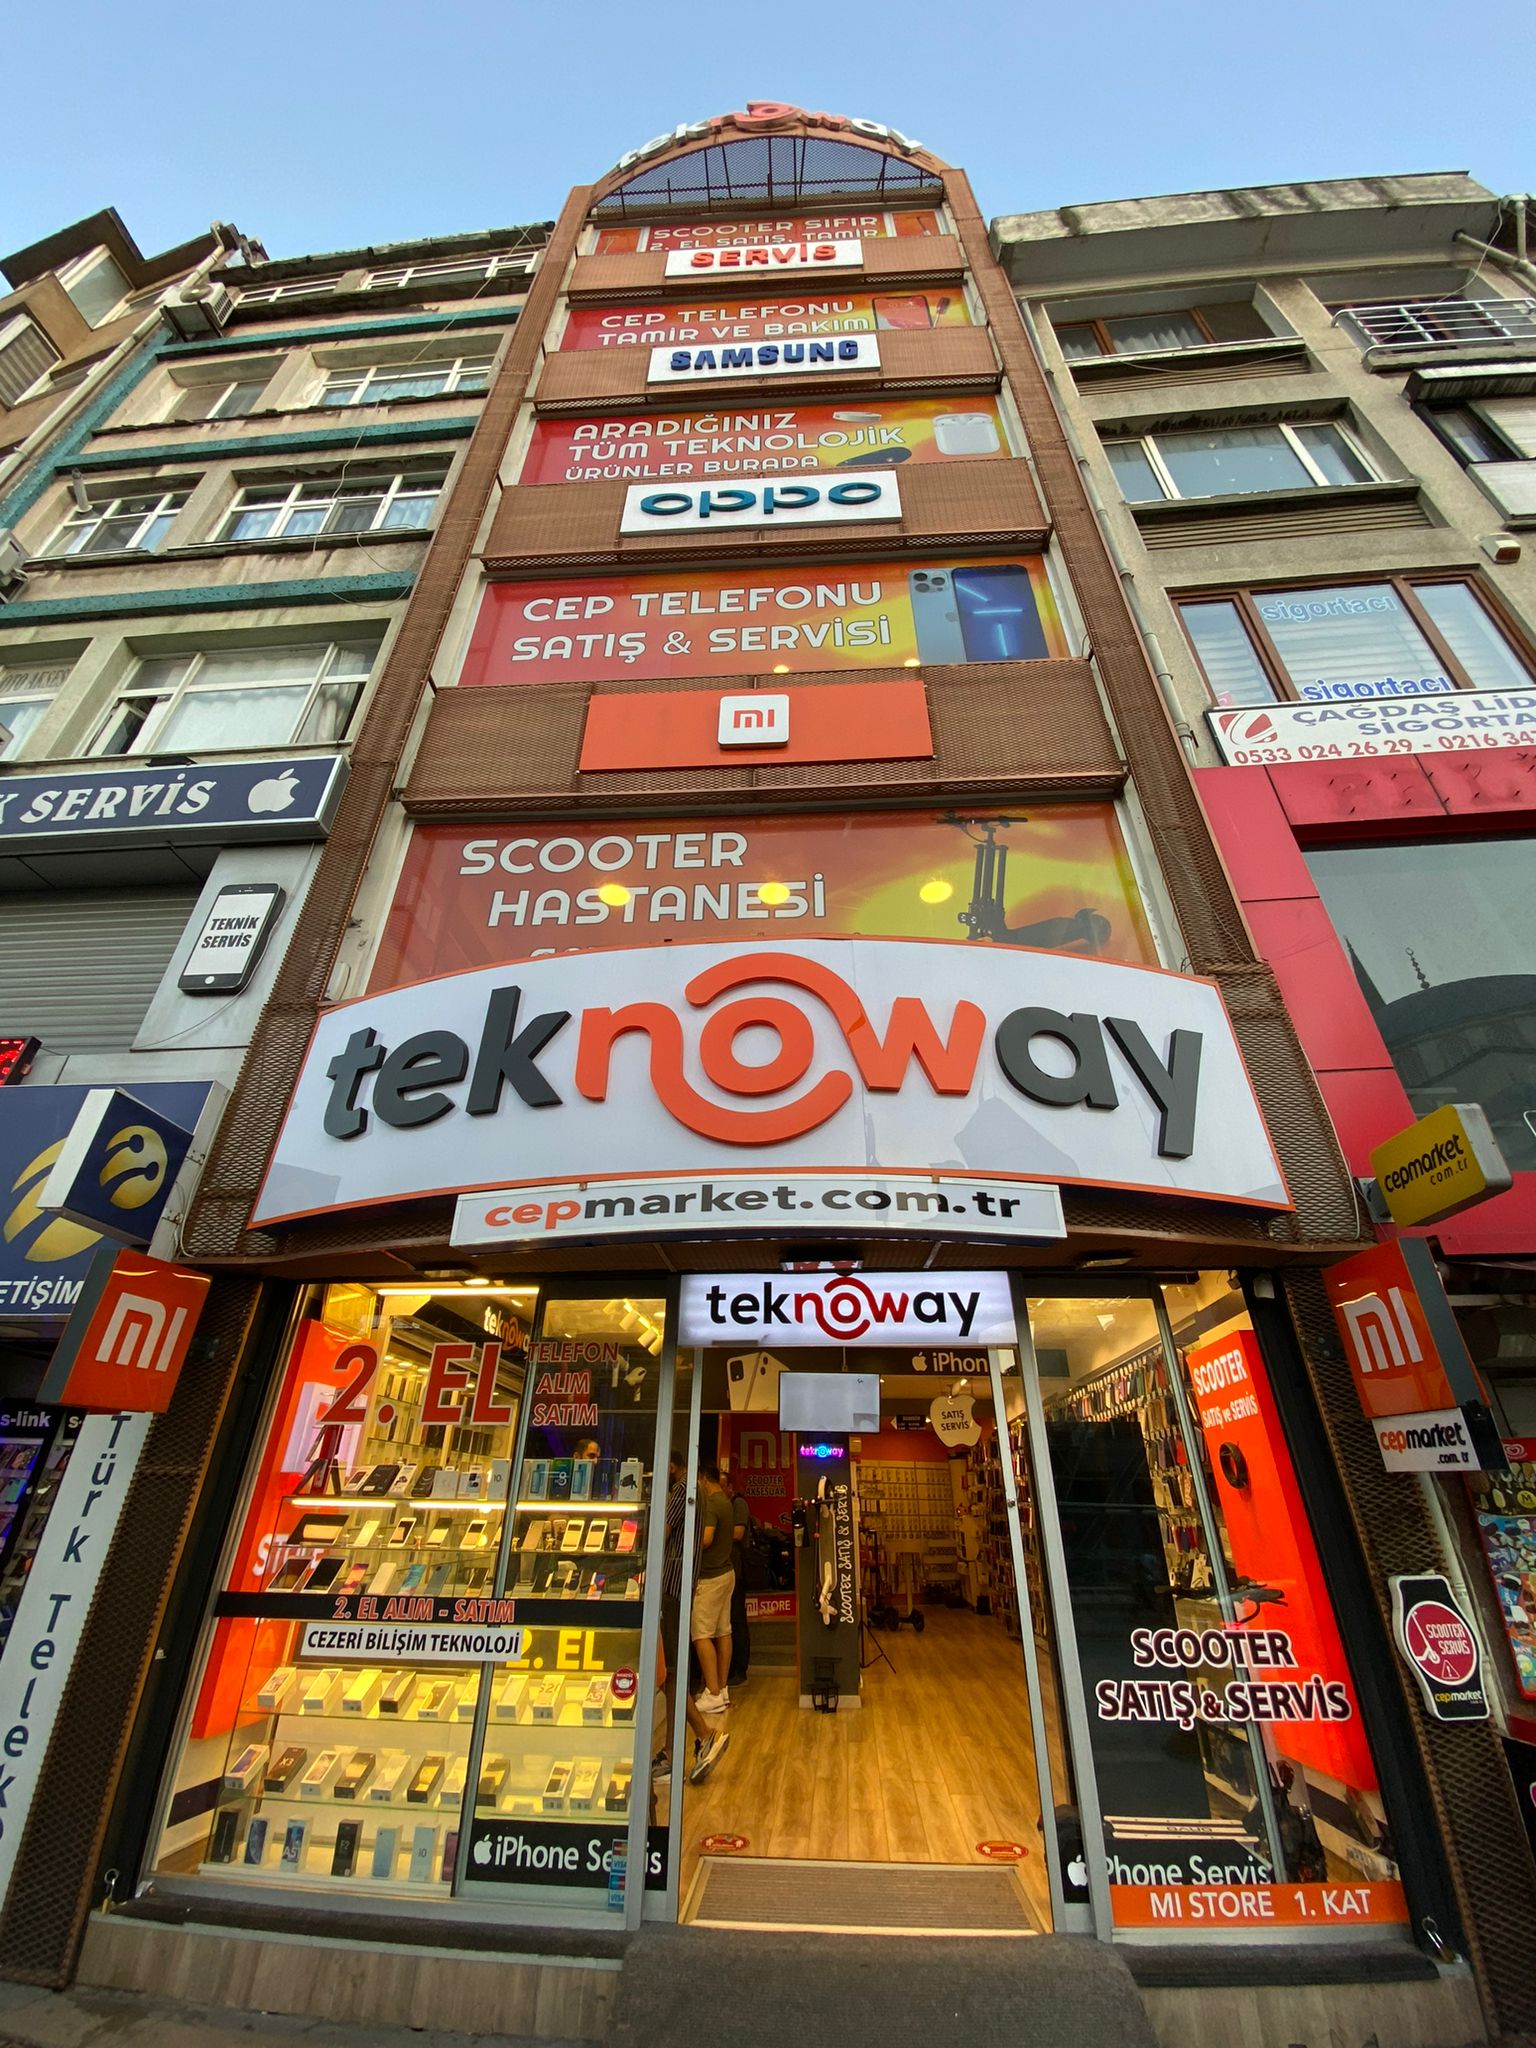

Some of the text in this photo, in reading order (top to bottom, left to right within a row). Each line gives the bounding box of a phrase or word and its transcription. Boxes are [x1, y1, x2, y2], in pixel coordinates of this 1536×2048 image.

[654, 216, 878, 240] SCOOTER SIFIR
[680, 240, 707, 249] EL
[801, 227, 878, 240] TAMİR
[691, 241, 836, 268] SERVİS
[601, 301, 853, 328] CEP TELEFONU
[598, 317, 869, 346] TAMİR VE BAKIM
[670, 340, 859, 371] SAMSUNG
[573, 411, 798, 440] ARADIĞINIZ
[568, 426, 906, 462] TÜM TEKNOLOJİK
[565, 455, 818, 481] ÜRÜNLER BURADA
[640, 482, 882, 518] oppo
[522, 581, 882, 622] CEP TELEFONU
[511, 615, 891, 664] SATIŞ & SERVİSİ
[1292, 698, 1460, 726] ÇAĞDAŞ
[1359, 712, 1536, 736] SİGORTA
[1234, 747, 1292, 764] 0533
[1299, 742, 1342, 760] 024
[1347, 740, 1378, 756] 26
[1384, 738, 1412, 754] 29
[1438, 733, 1498, 750] 0216
[1502, 730, 1536, 746] 34
[19, 773, 217, 824] SERVİS
[458, 832, 748, 875] SCOOTER
[487, 872, 826, 927] HASTANESİ
[209, 914, 260, 931] TEKNİK
[201, 932, 252, 949] SERVİS
[323, 952, 1203, 1158] teknoway
[1384, 1133, 1465, 1193] cepmarket
[484, 1184, 1020, 1230] cepmarket.com.tr
[706, 1276, 980, 1341] teknoway
[528, 1341, 619, 1363] TELEFON
[933, 1351, 989, 1373] iPhon
[320, 1342, 515, 1427] 2. EL
[536, 1372, 590, 1395] ALIM
[1193, 1349, 1248, 1396] SCOOTER
[0, 1410, 51, 1428] s-link
[532, 1403, 599, 1426] SATIM
[941, 1409, 965, 1422] SATIŞ
[1230, 1391, 1258, 1421] SERVİS
[1380, 1422, 1466, 1453] cepmarket
[838, 1525, 849, 1536] &
[838, 1540, 853, 1570] SATIŞ
[332, 1595, 351, 1620] 2.
[357, 1597, 379, 1621] EL
[382, 1597, 433, 1622] ALIM
[453, 1599, 515, 1624] SATIM
[760, 1600, 791, 1611] STORE
[840, 1573, 855, 1624] SCOOTER
[307, 1628, 520, 1656] CEZERİ BİLİŞİM TEKNOLOJİ
[1426, 1623, 1466, 1638] SCOOTER
[556, 1629, 604, 1671] EL
[1130, 1628, 1299, 1668] SCOOTER
[1438, 1637, 1471, 1655] SERVİS
[1096, 1674, 1353, 1731] SATIŞ & SERVİS
[1435, 1689, 1483, 1703] cepmarket
[495, 1834, 580, 1871] iPhone
[1188, 1855, 1272, 1886] Servis
[1151, 1889, 1371, 1918] MI STORE 1. KAT
